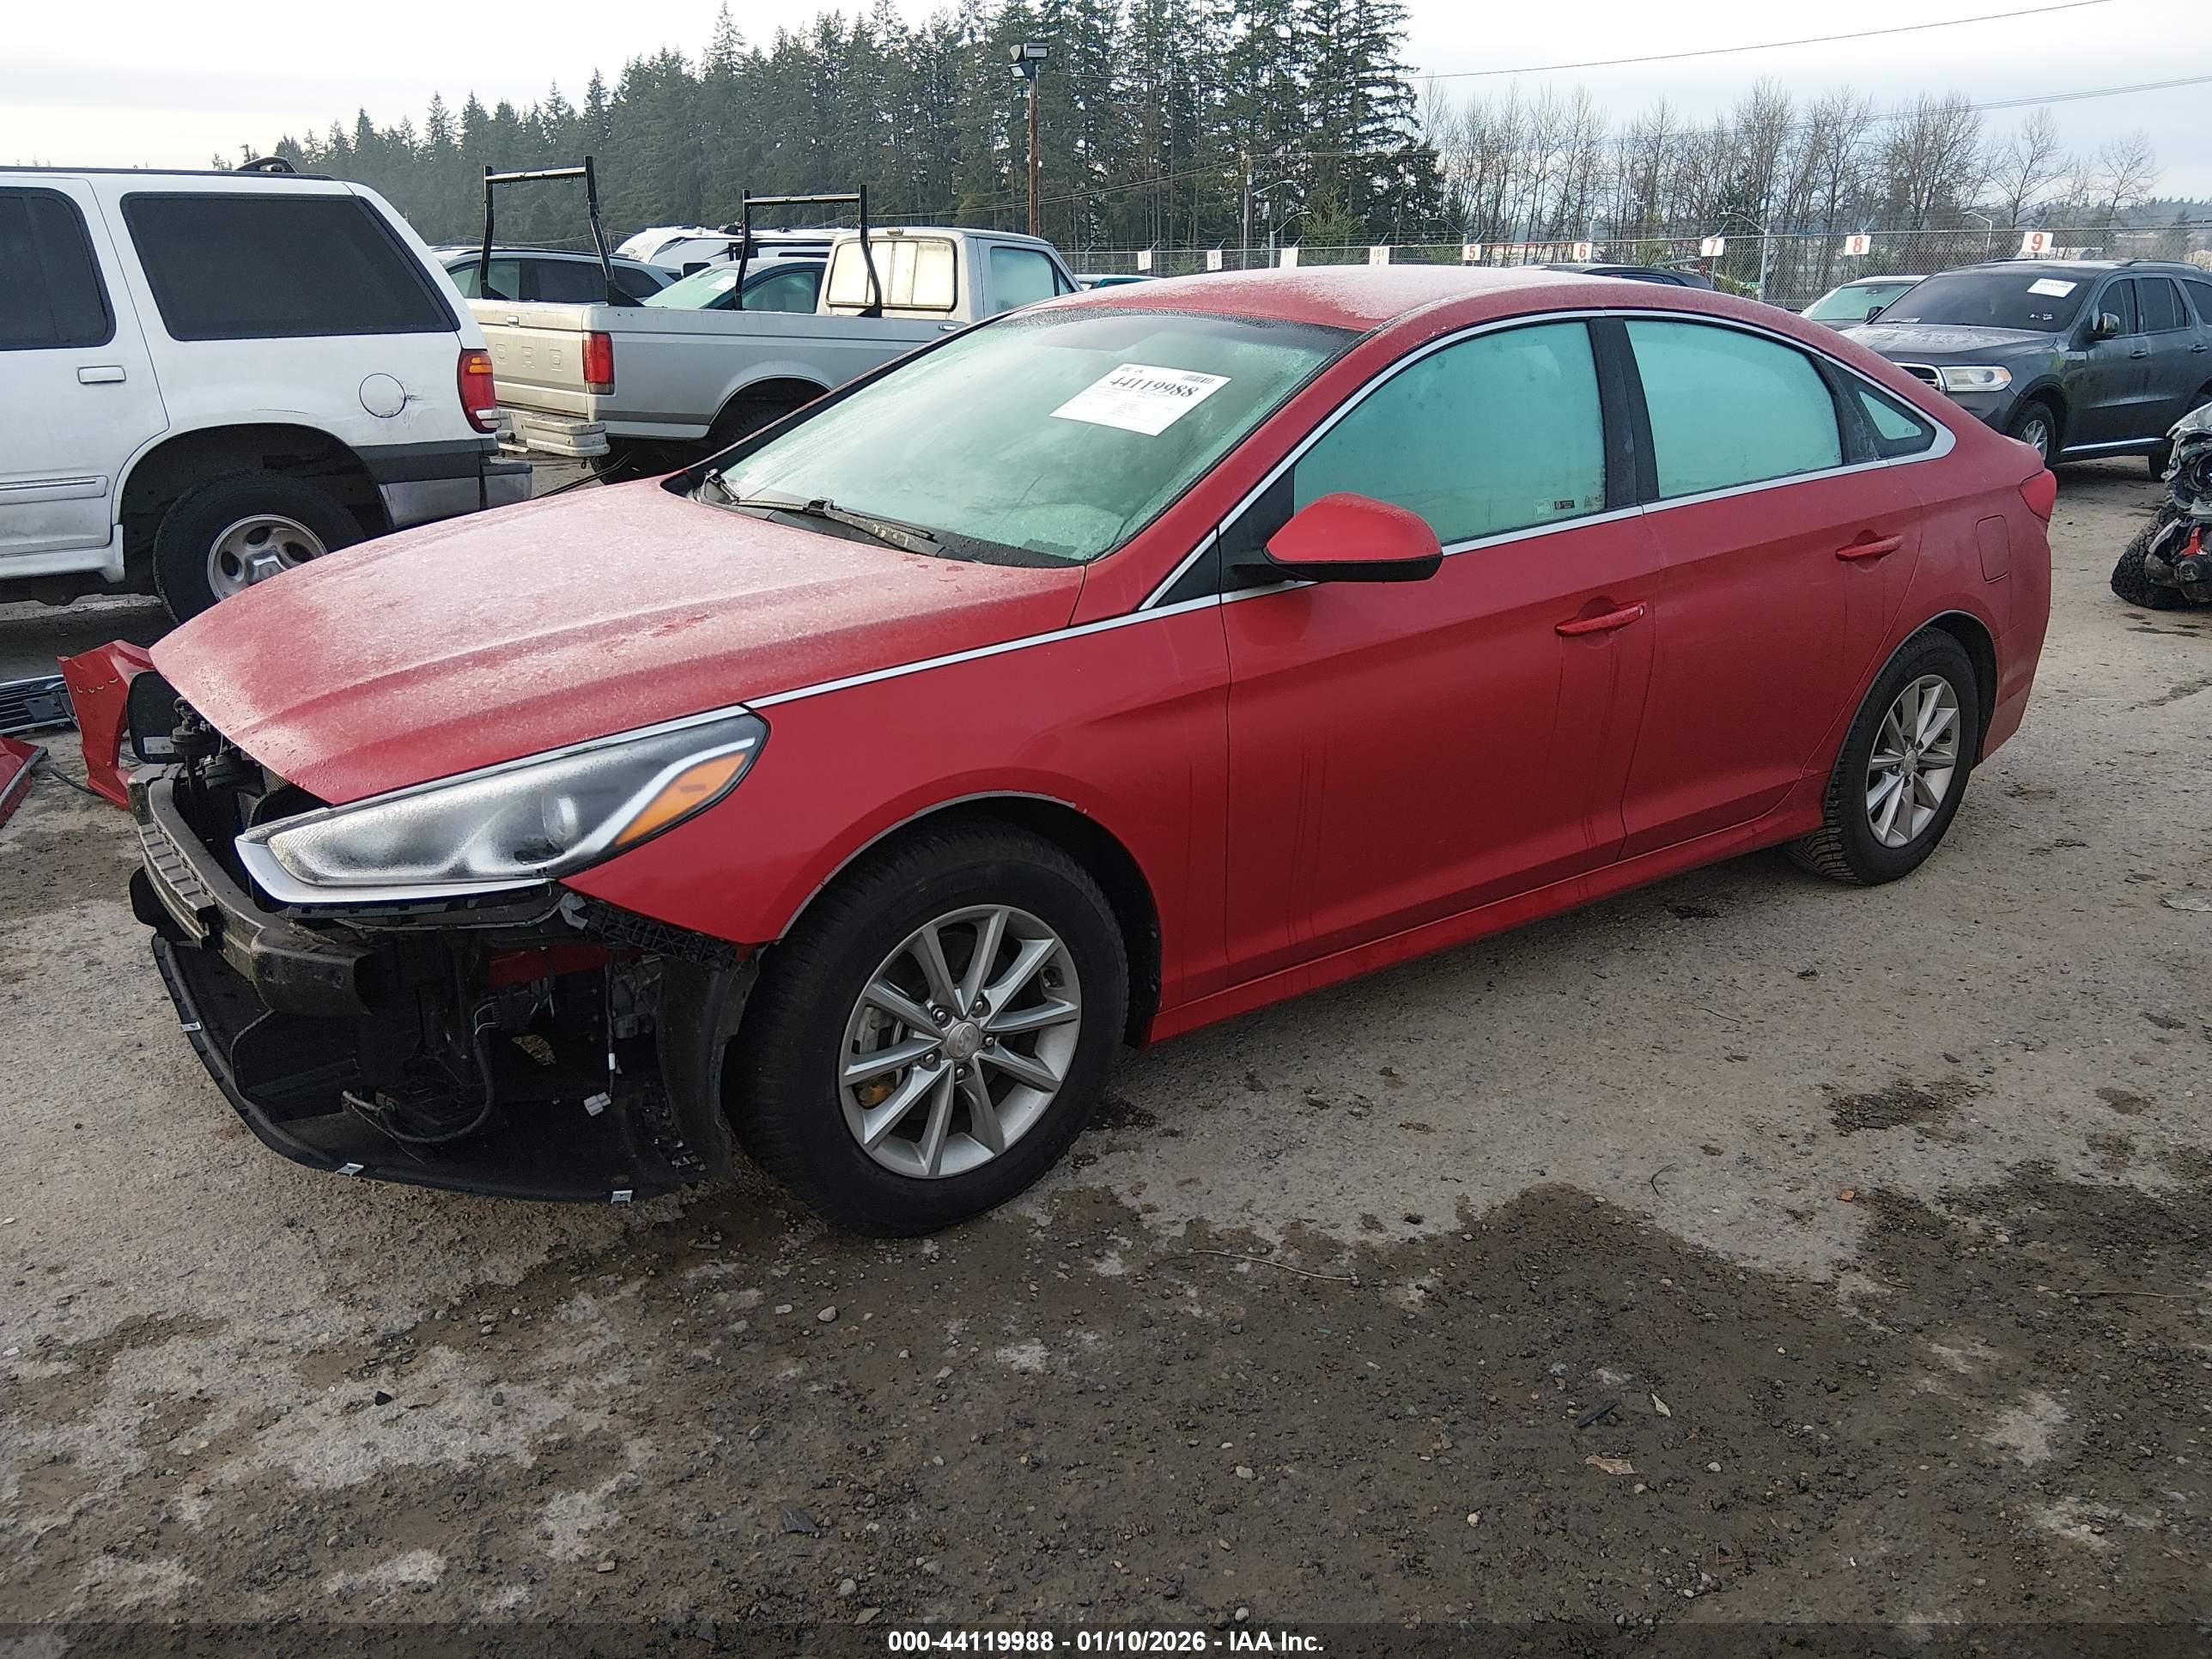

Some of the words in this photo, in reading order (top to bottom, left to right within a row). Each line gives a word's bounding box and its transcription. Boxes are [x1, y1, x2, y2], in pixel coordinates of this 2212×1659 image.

[1578, 243, 1587, 258] 6
[1710, 239, 1718, 256] 7
[1852, 236, 1863, 253] 8
[2031, 233, 2044, 252] 9
[1468, 246, 1476, 259] 5
[495, 343, 563, 372] ORD
[1109, 375, 1200, 398] 44119988
